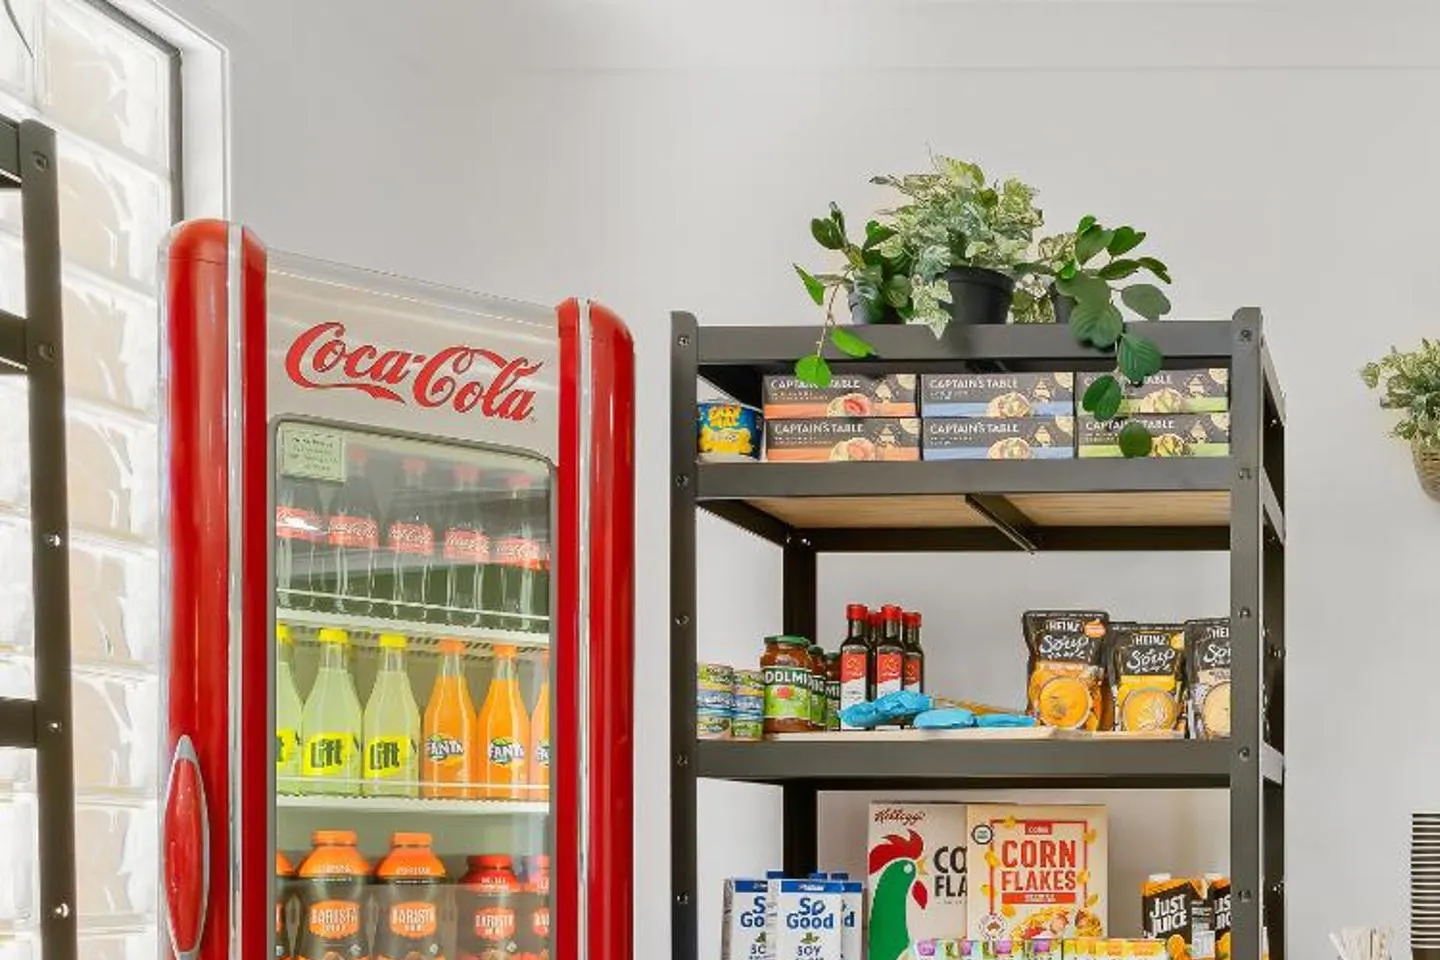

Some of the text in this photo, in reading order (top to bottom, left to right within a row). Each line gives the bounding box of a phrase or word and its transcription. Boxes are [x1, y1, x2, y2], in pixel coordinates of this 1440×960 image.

[284, 320, 544, 422] Coca-Cola
[986, 378, 1018, 389] TABLE
[831, 423, 865, 433] TABLE
[986, 423, 1020, 433] TABLE
[1049, 620, 1080, 632] HEINZ
[1212, 627, 1230, 638] HEI
[1136, 634, 1166, 645] HEINZ
[311, 738, 342, 769] Lift
[370, 741, 400, 771] Lift
[933, 845, 968, 875] CO
[1001, 840, 1076, 868] CORN
[935, 875, 968, 898] FLA
[1001, 870, 1076, 891] FLAKES
[753, 896, 766, 914] S
[799, 898, 826, 915] So
[740, 912, 765, 928] Go
[786, 912, 834, 930] Good
[1147, 911, 1188, 938] JUICE
[797, 945, 822, 957] SOY
